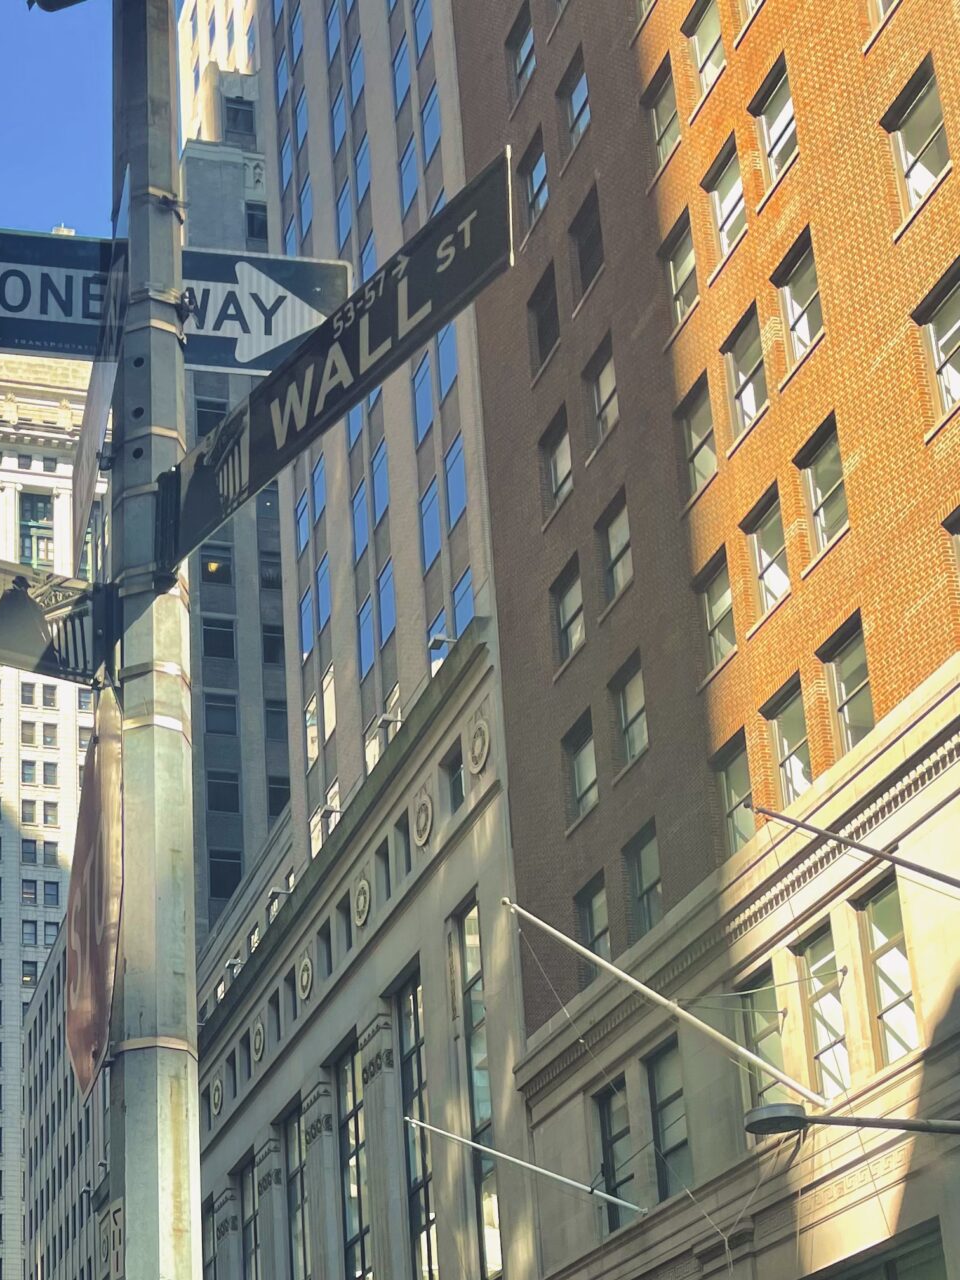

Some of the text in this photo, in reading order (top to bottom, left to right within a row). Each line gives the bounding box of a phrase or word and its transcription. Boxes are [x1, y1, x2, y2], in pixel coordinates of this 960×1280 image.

[182, 286, 289, 337] WAY
[271, 209, 478, 450] WALL ST
[333, 271, 387, 340] 53-57
